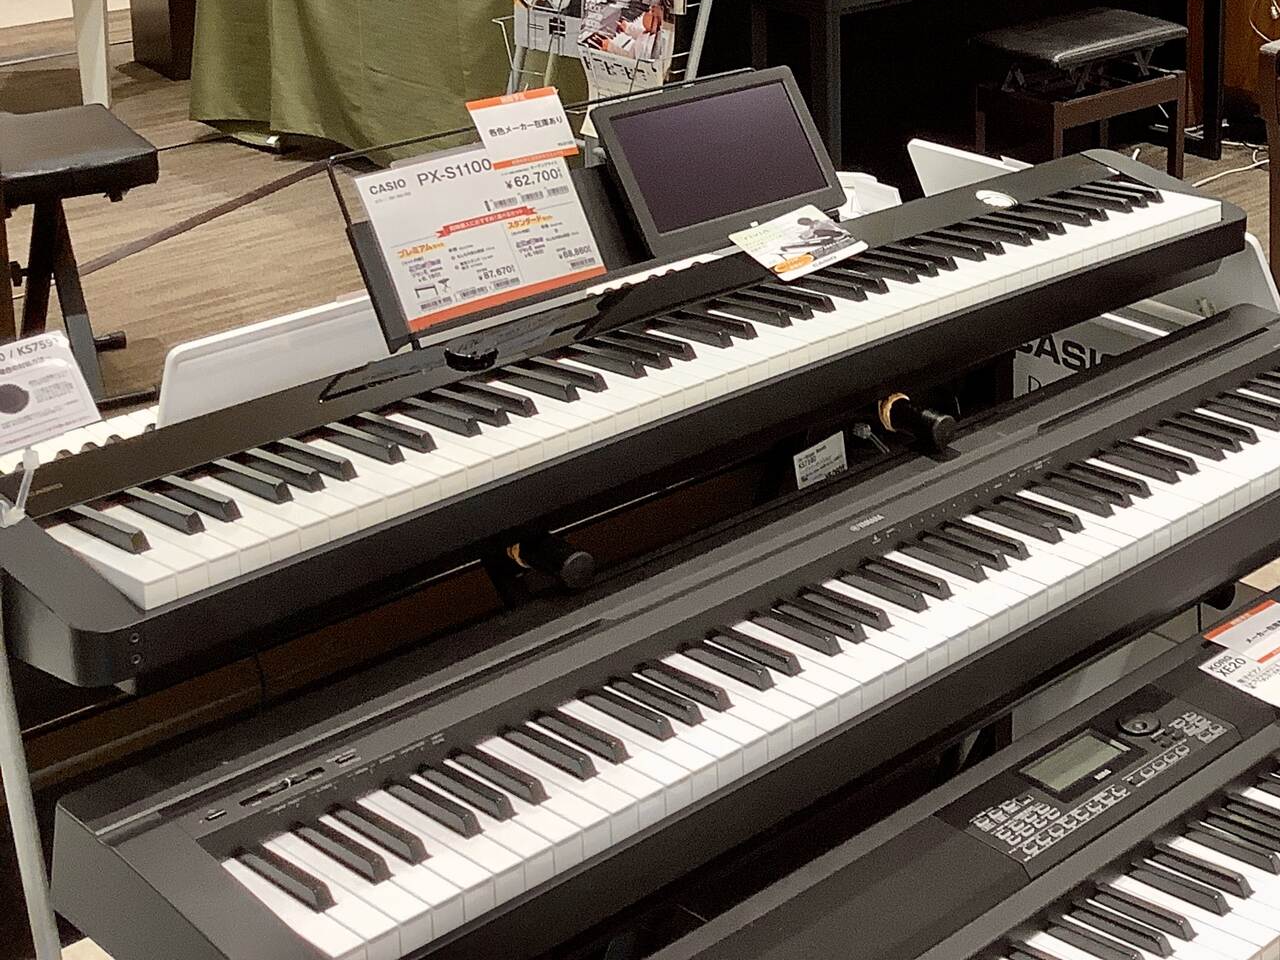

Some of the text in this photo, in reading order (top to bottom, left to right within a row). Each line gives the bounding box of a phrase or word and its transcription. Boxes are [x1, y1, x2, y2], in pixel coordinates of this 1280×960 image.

[488, 116, 563, 137] 各色メーカー在庫あり
[369, 158, 492, 195] CASIO PX-S1100
[1018, 334, 1114, 373] ASI
[1208, 655, 1233, 671] KORG
[1217, 657, 1247, 677] XE20
